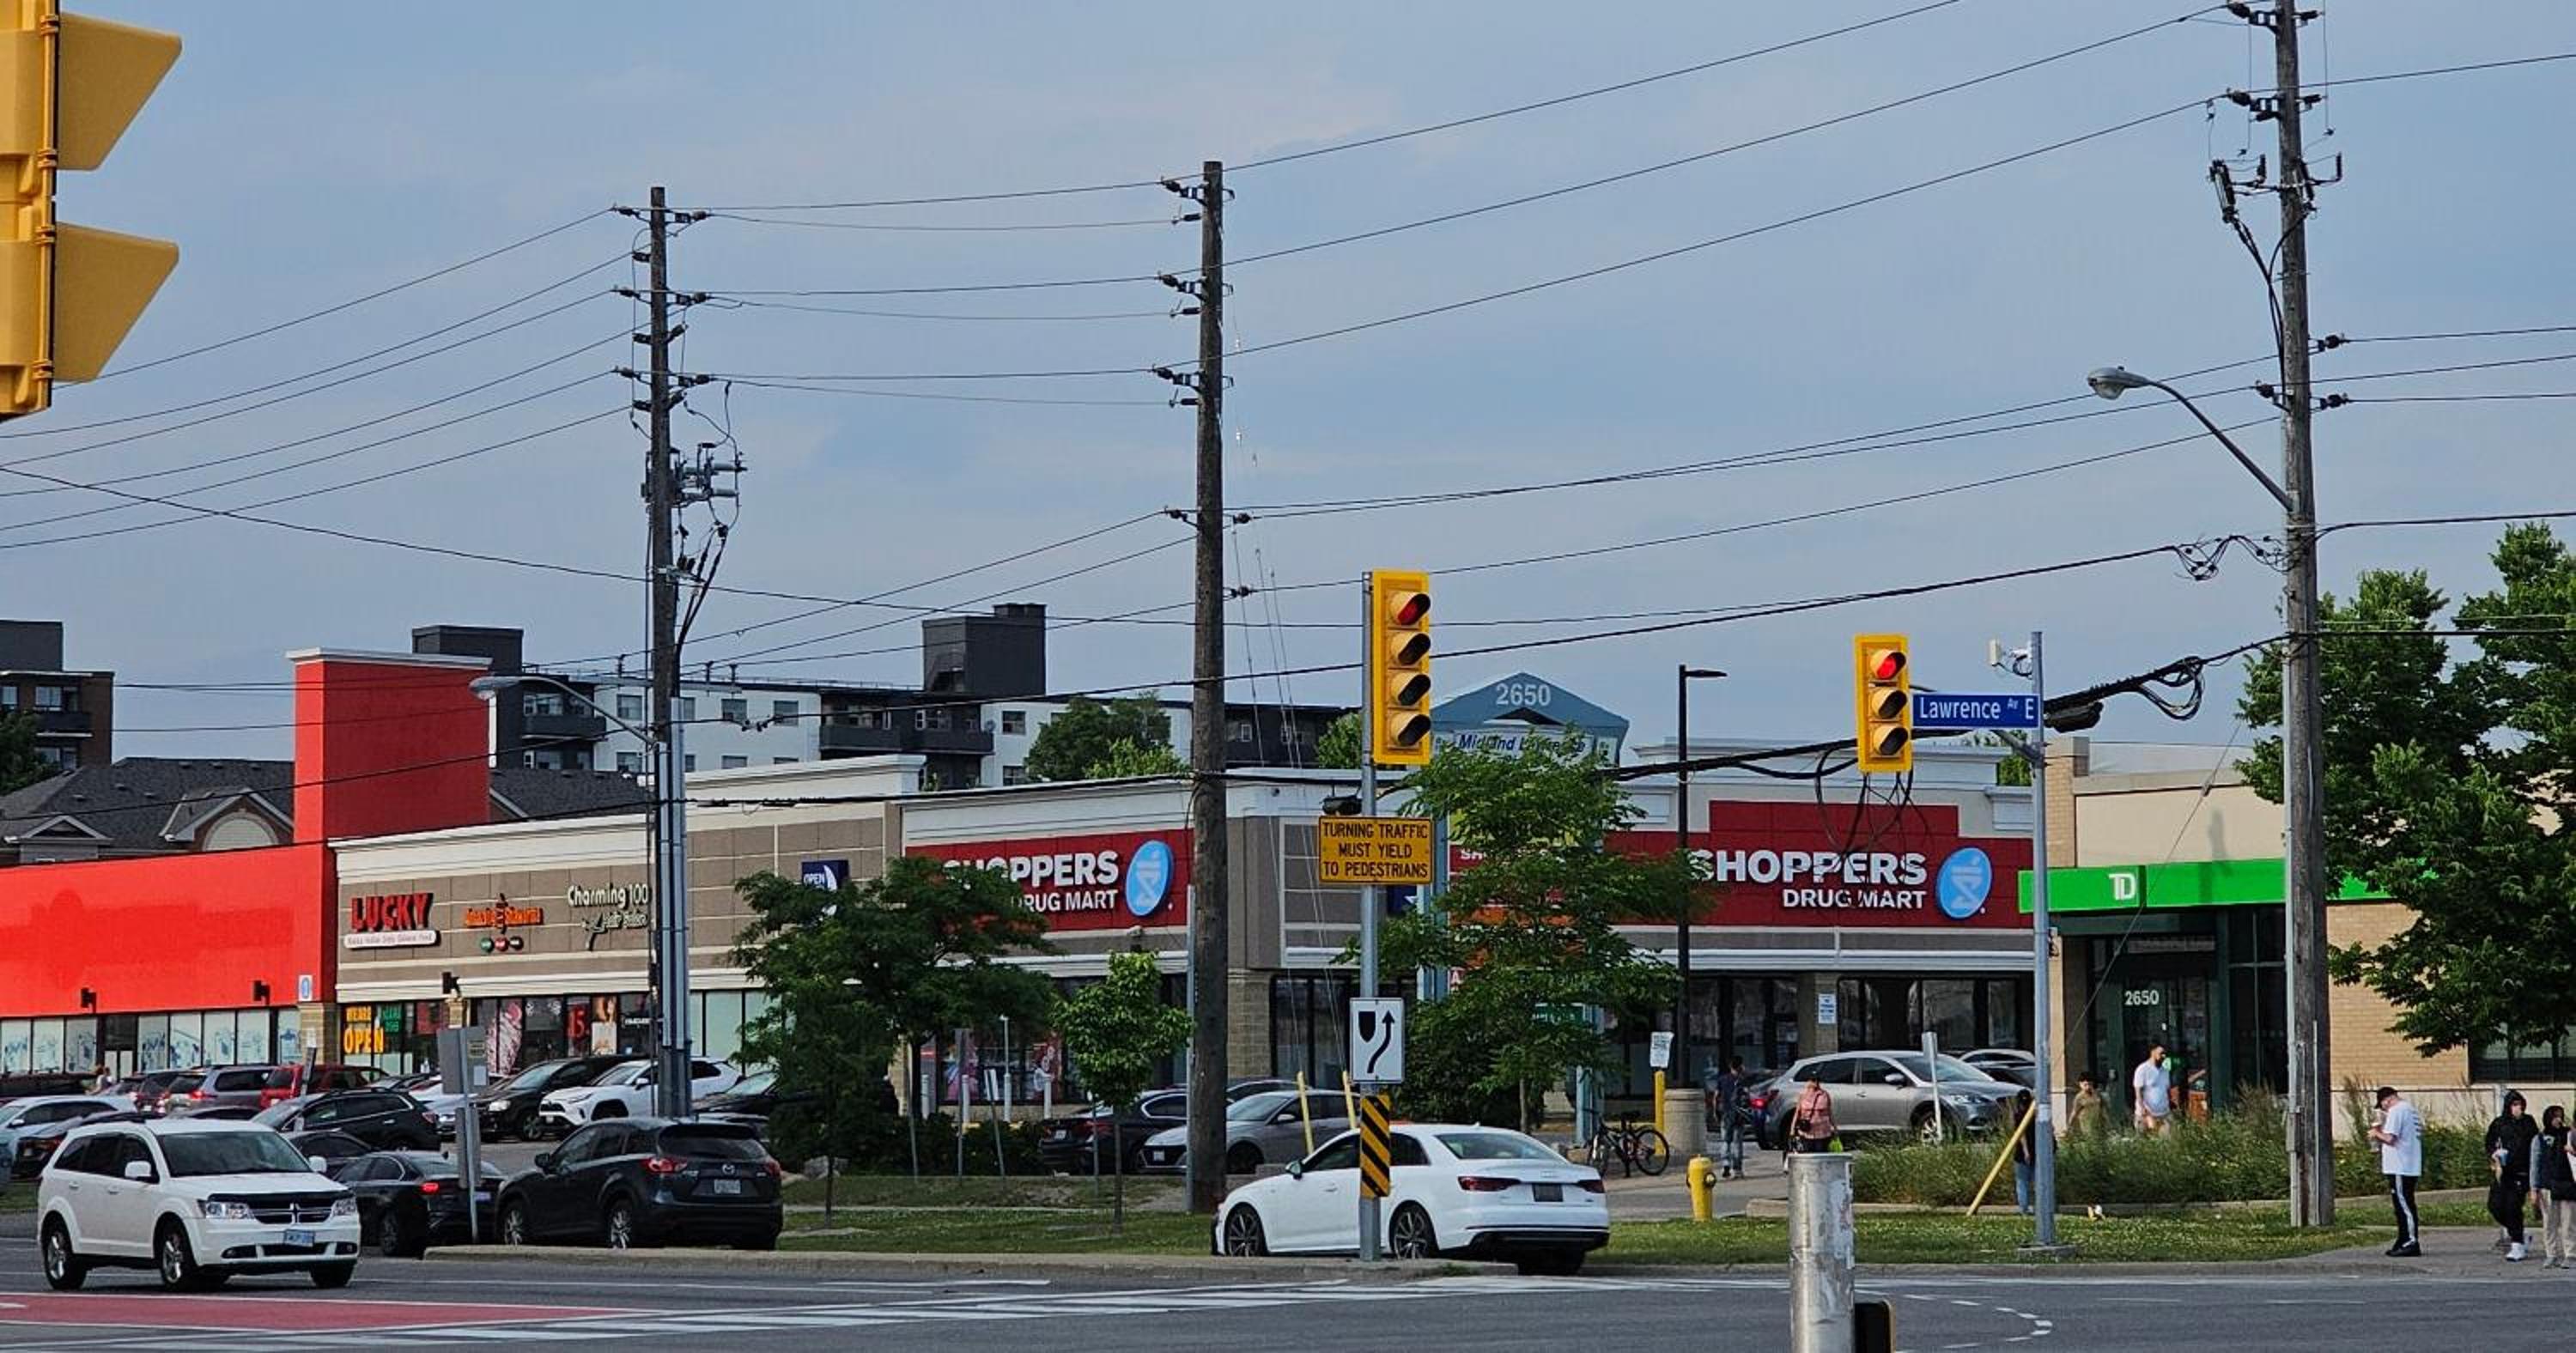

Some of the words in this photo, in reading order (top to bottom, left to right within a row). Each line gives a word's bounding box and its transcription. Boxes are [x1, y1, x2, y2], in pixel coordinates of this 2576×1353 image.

[1496, 683, 1552, 706] 2650
[1919, 696, 2002, 719] Lawrence
[2025, 697, 2035, 720] E
[1322, 822, 1374, 839] TURNING
[1378, 823, 1428, 839] TRAFFIC
[1338, 842, 1371, 858] MUST
[1377, 843, 1413, 859] YIELD
[1323, 861, 1339, 877] TO
[1345, 861, 1429, 878] PEDESTRIANS
[1689, 849, 1928, 885] SHOPPERS
[567, 883, 626, 909] Charming
[629, 883, 648, 904] 100
[1783, 889, 1852, 908] DRUG
[1857, 890, 1927, 909] MART
[2108, 873, 2136, 901] TD
[350, 892, 431, 931] LUCKY
[1011, 891, 1061, 913] RUG
[1066, 889, 1119, 911] MART
[2124, 990, 2160, 1006] 2650
[343, 1027, 384, 1054] OPEN
